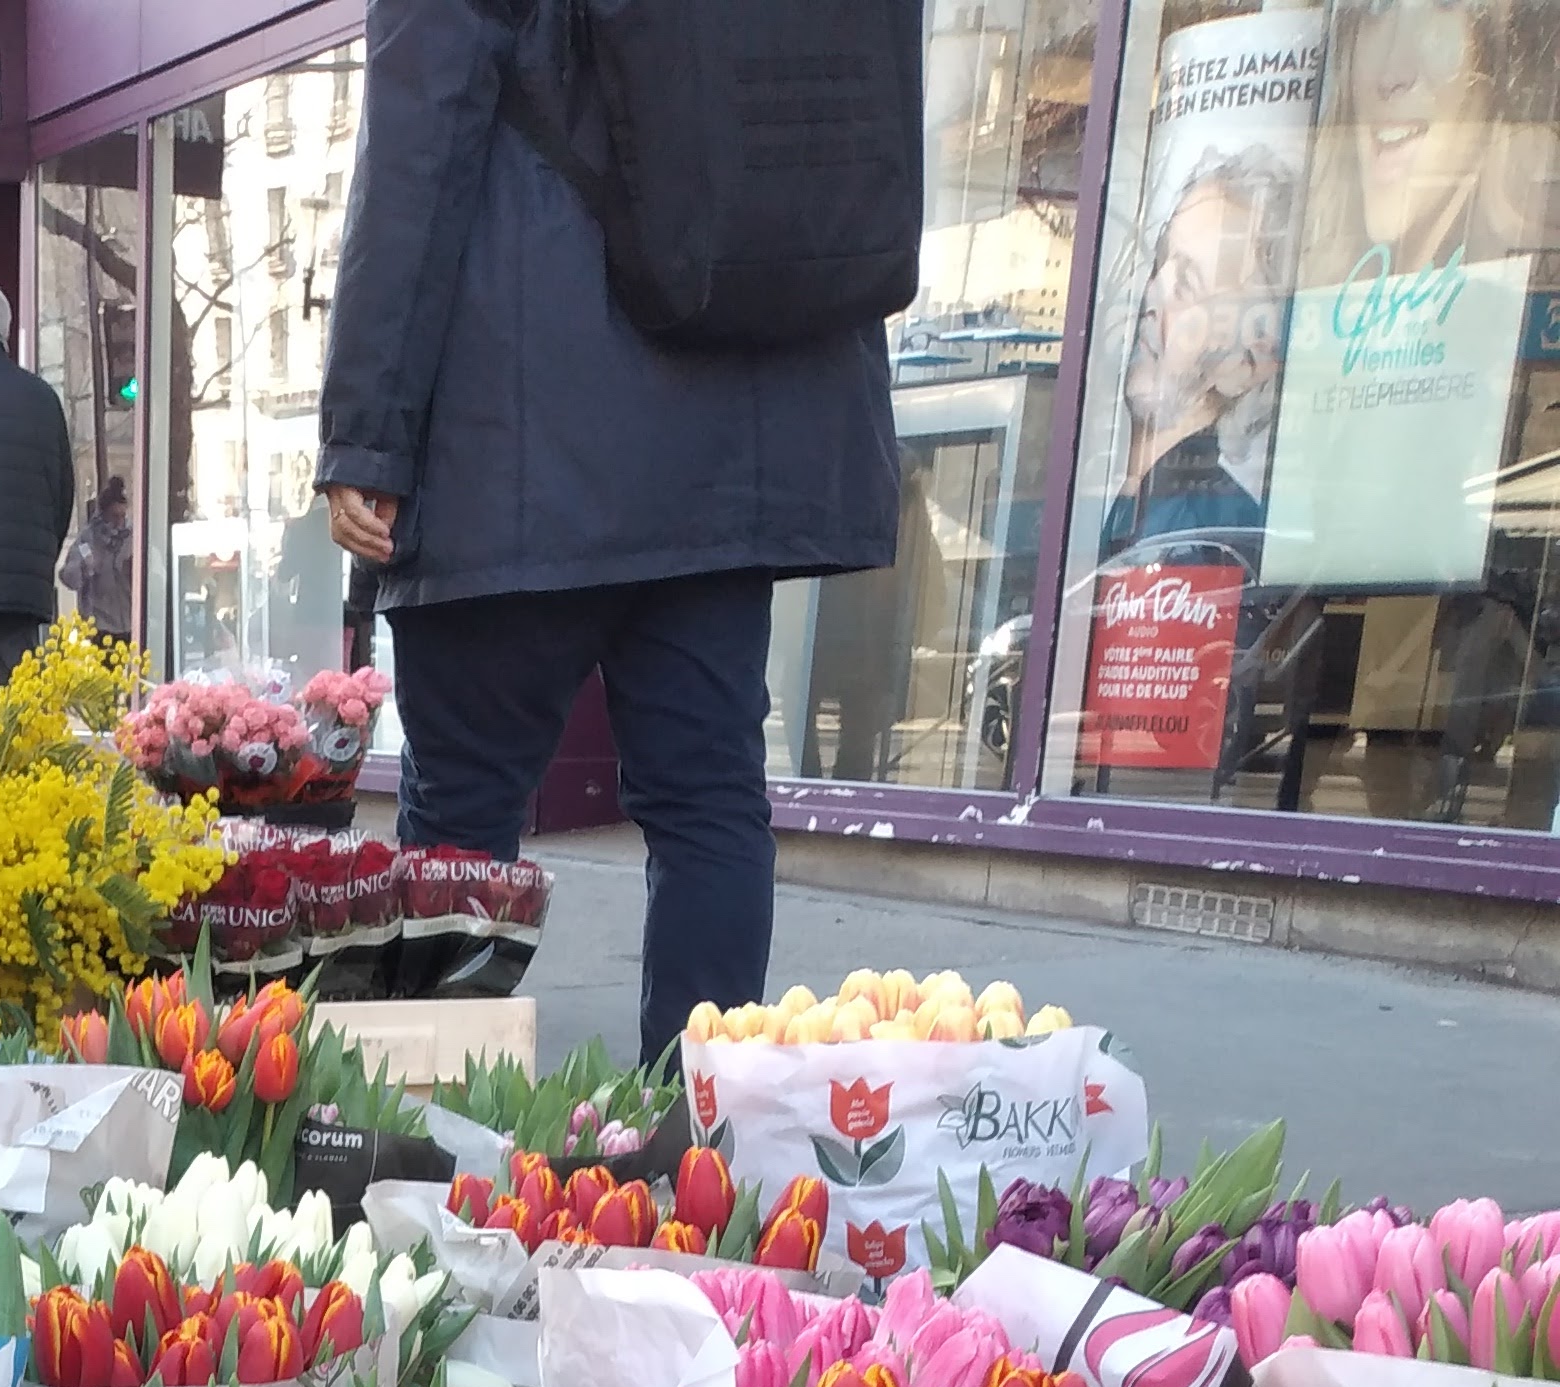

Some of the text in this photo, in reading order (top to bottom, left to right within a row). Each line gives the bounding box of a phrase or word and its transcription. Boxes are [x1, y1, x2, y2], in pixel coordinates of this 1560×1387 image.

[1232, 46, 1322, 78] JAMAIS
[1198, 77, 1316, 113] ENTENDRE
[1363, 341, 1446, 373] lentilles
[1154, 648, 1195, 663] PAIRE
[1130, 666, 1200, 681] AUDITIVES
[450, 861, 508, 883] UNICA
[301, 1128, 363, 1150] corum
